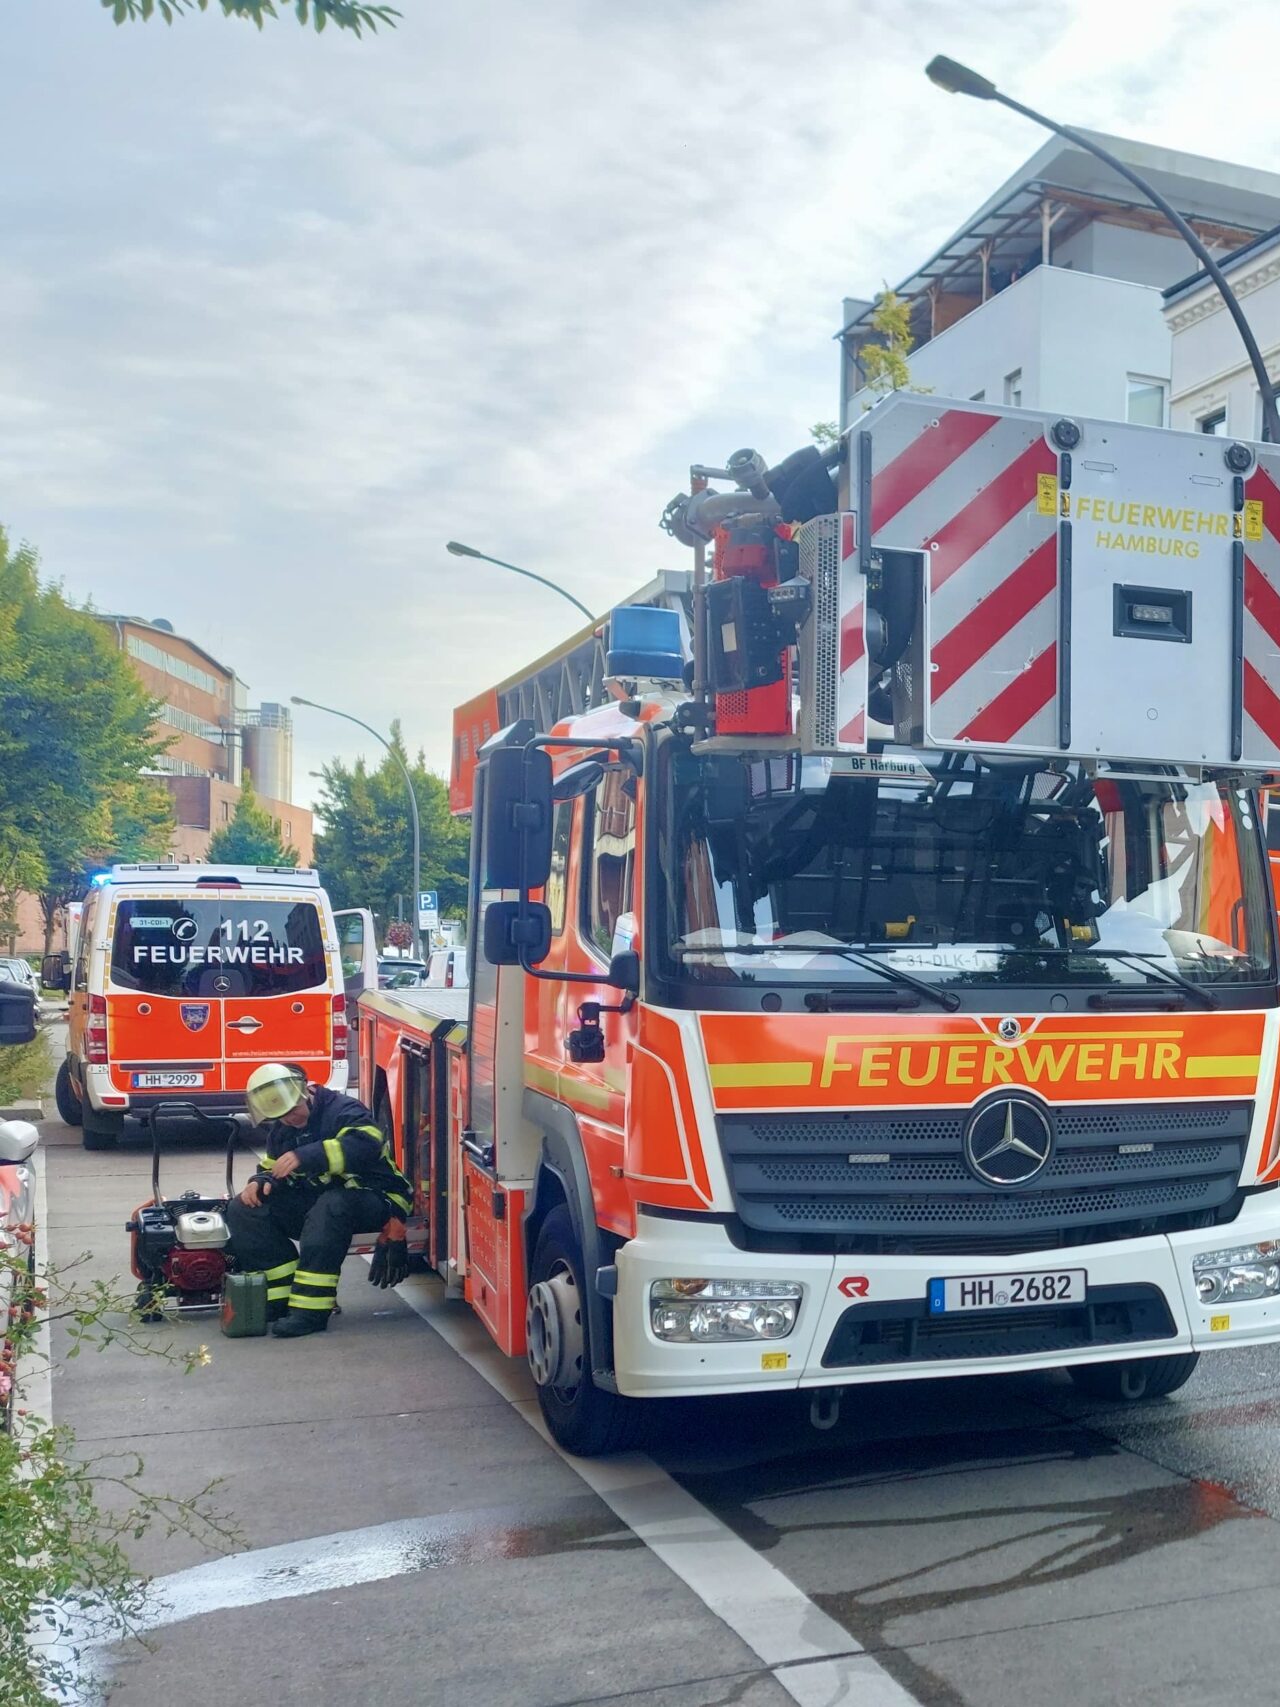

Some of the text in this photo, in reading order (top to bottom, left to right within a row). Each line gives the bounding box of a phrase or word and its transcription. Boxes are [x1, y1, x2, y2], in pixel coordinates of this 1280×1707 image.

[1075, 498, 1230, 537] FEUERWEHR
[1096, 530, 1200, 559] HAMBURG
[851, 757, 915, 774] BF Harburg
[420, 894, 432, 909] P
[220, 919, 269, 941] 112
[133, 945, 304, 964] FEUERWEHR
[906, 954, 979, 967] 31-DLK-1
[819, 1033, 1184, 1088] FEUERWEHR
[145, 1074, 197, 1085] HH 2999
[960, 1280, 994, 1307] HH
[1010, 1275, 1071, 1303] 2682
